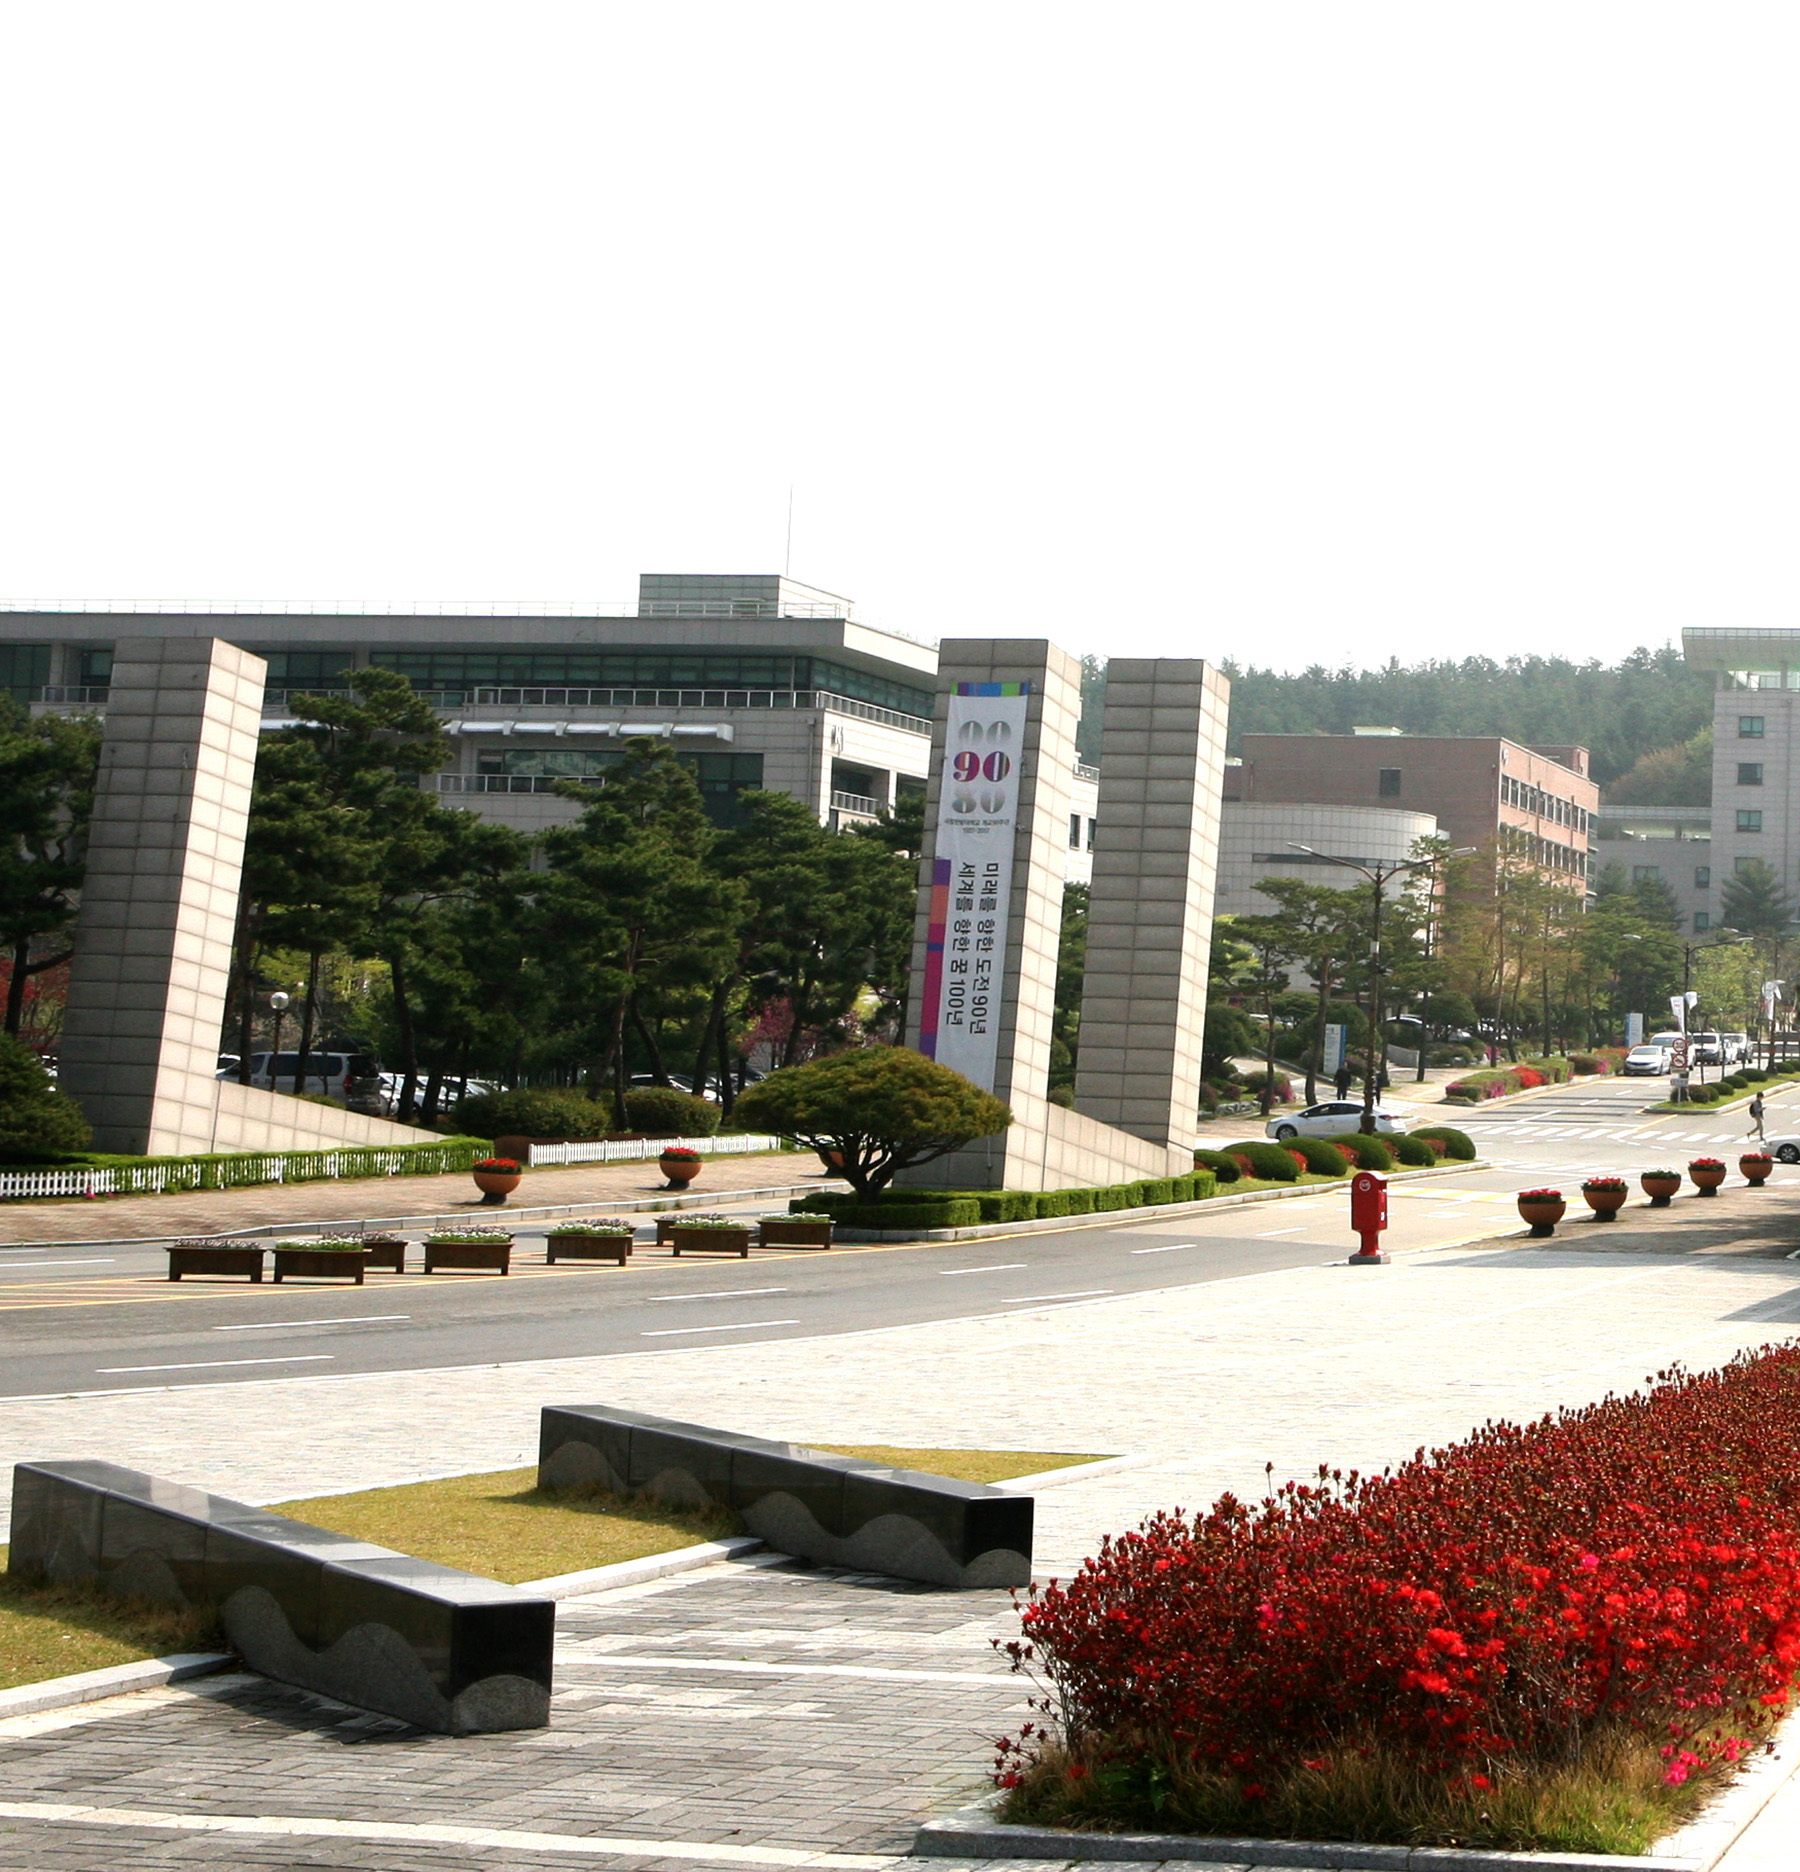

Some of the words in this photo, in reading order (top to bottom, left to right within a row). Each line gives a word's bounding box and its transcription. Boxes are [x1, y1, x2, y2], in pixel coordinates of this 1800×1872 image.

[953, 751, 1010, 782] 90
[955, 862, 976, 913] 세계를
[979, 863, 999, 912] 미래를
[952, 919, 972, 953] 향한
[975, 919, 996, 953] 향한
[950, 960, 968, 974] 꿈
[972, 959, 992, 991] 도전
[946, 979, 966, 1025] 100년
[969, 996, 988, 1034] 90년
